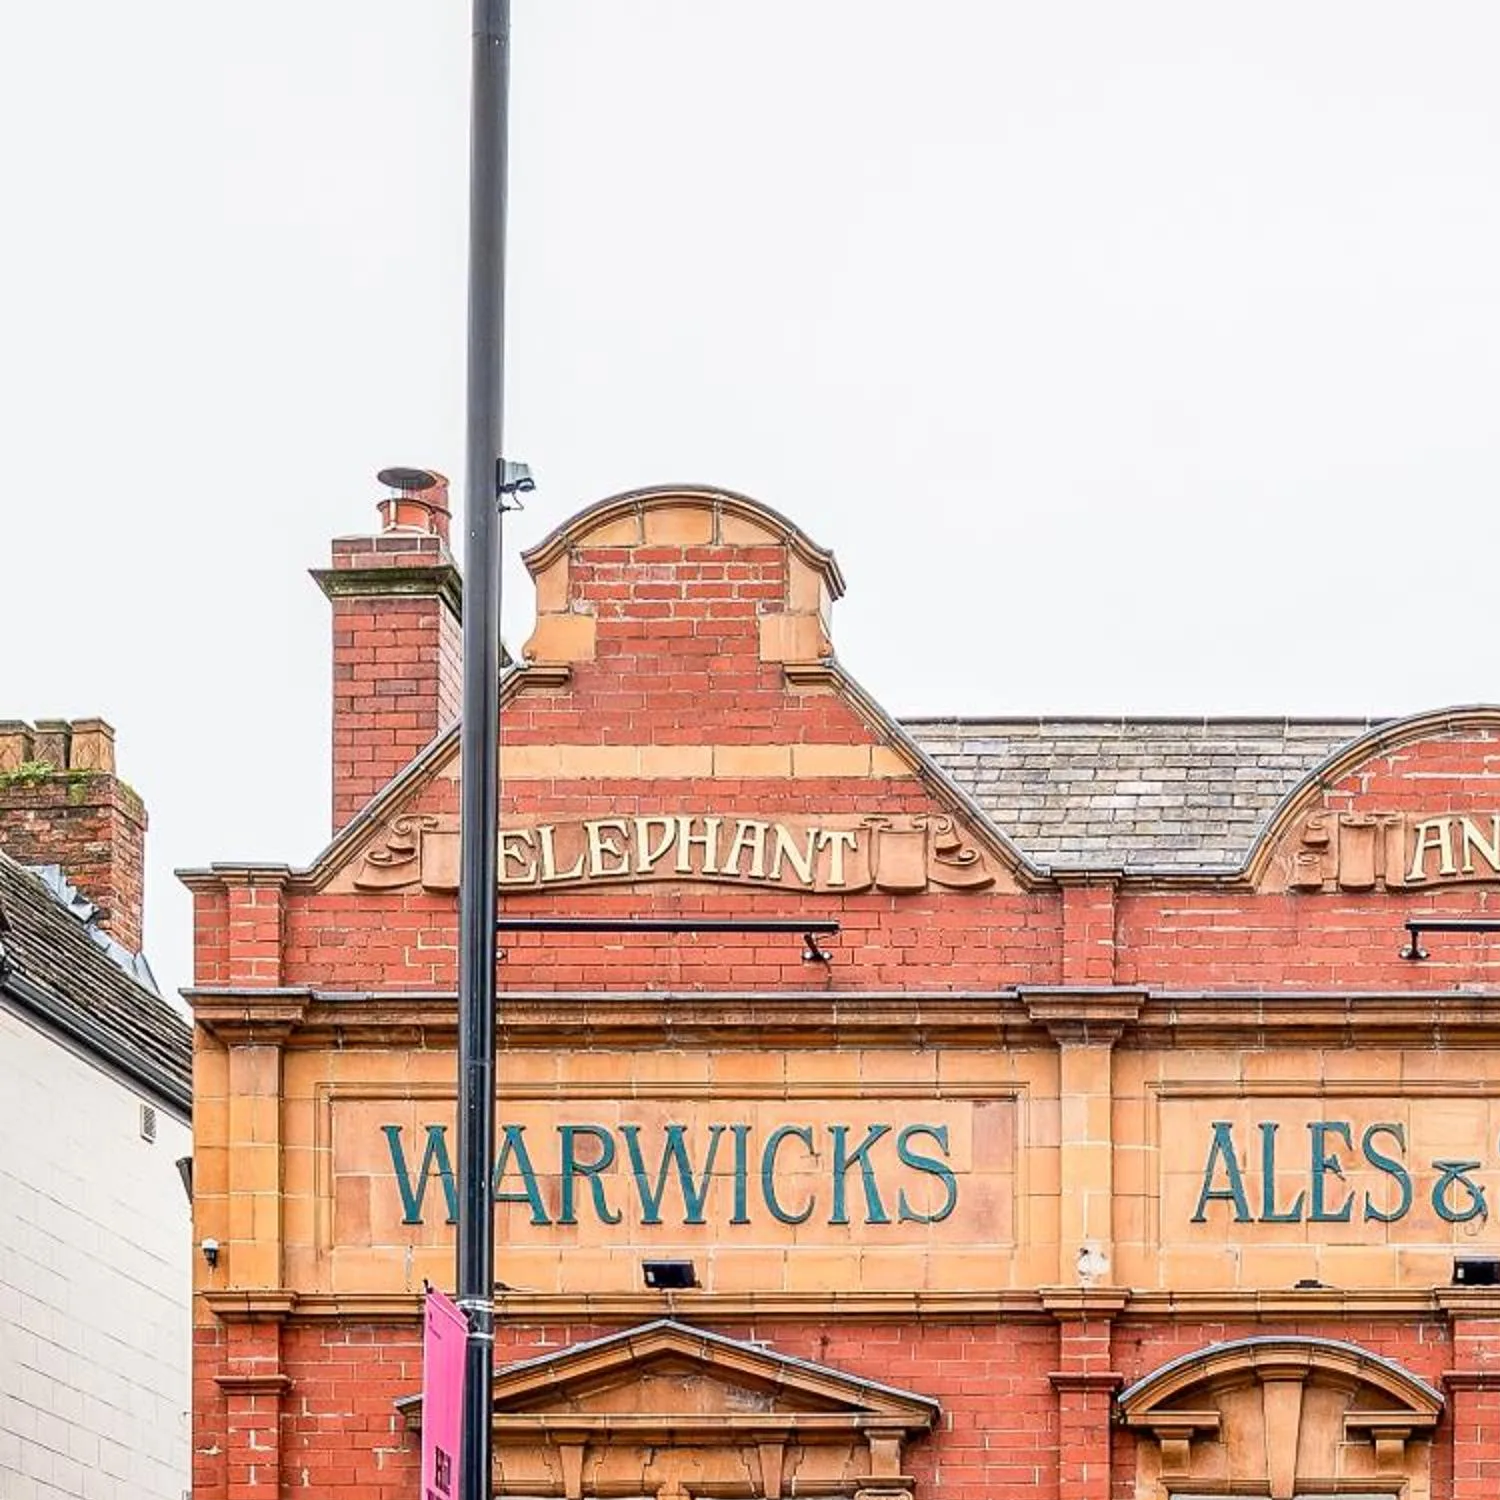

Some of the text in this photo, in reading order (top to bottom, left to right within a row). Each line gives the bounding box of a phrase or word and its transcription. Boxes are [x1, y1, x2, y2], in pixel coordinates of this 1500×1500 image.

[498, 814, 858, 887] ELEPHANT
[380, 1123, 958, 1226] WARWICKS
[1190, 1121, 1413, 1224] ALES
[1431, 1159, 1490, 1236] &
